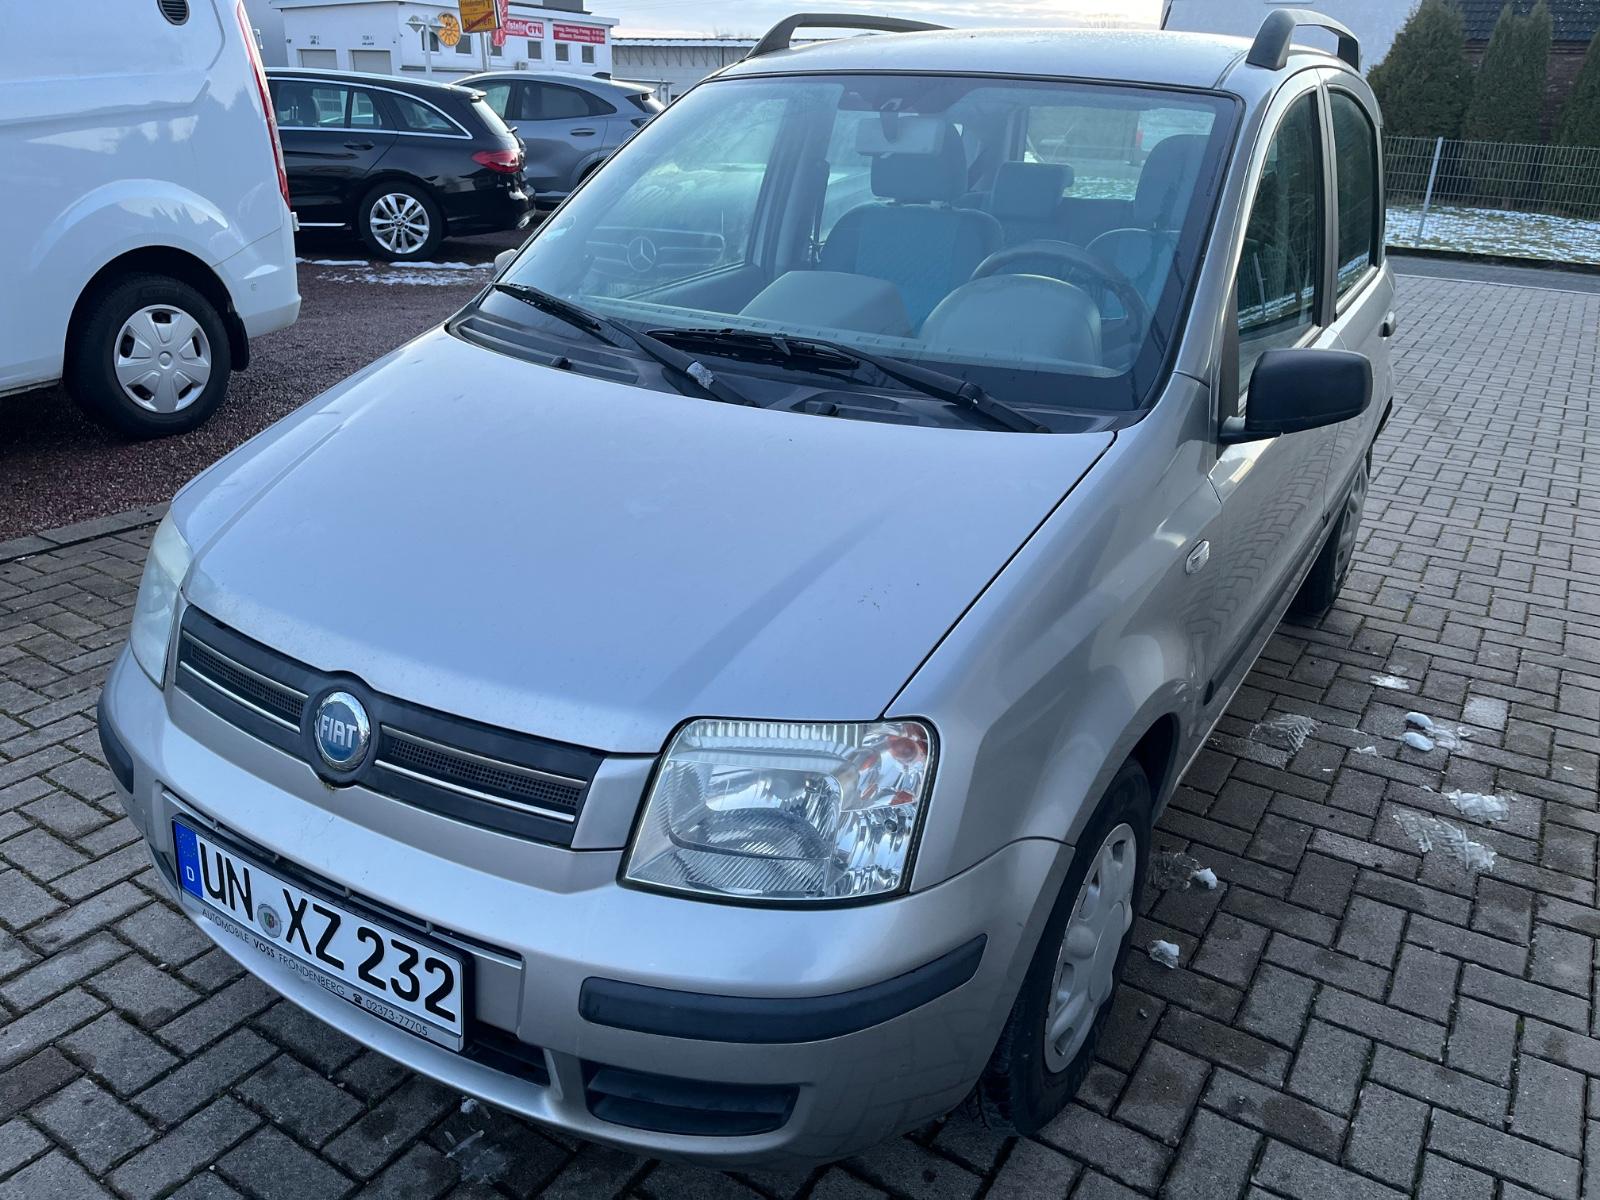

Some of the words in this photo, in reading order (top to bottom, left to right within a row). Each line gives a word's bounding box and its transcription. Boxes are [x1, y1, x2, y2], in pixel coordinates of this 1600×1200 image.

[320, 714, 357, 748] FIAT
[186, 865, 195, 882] D
[199, 841, 253, 921] UN
[282, 887, 345, 971] XZ
[357, 926, 456, 1023] 232
[202, 908, 249, 944] AUTOMOBILE
[253, 938, 275, 958] VOSS
[366, 999, 428, 1037] 02373-77705
